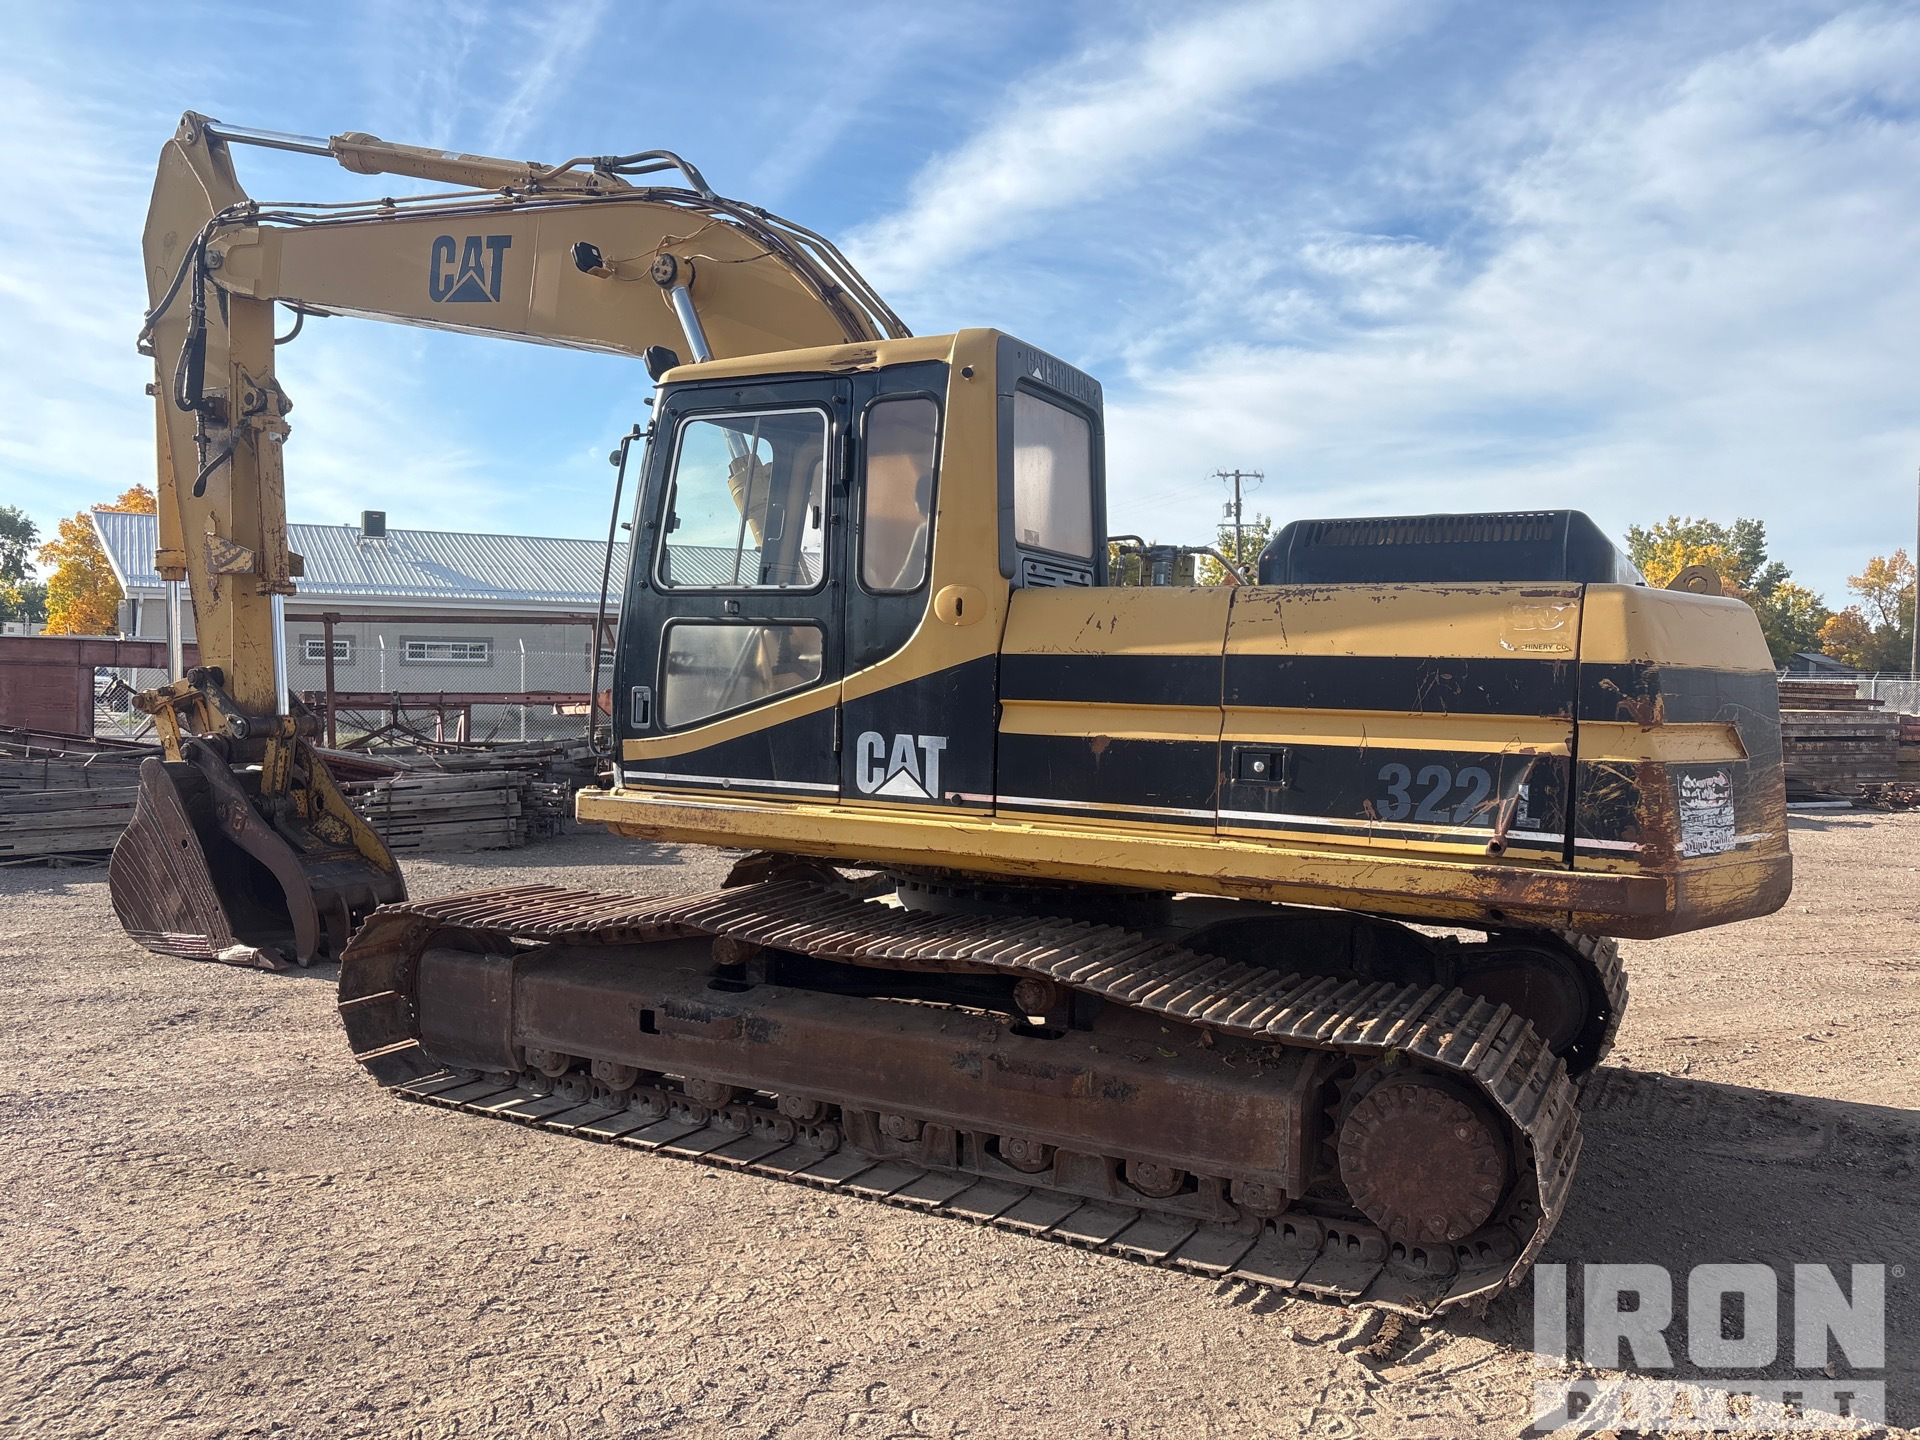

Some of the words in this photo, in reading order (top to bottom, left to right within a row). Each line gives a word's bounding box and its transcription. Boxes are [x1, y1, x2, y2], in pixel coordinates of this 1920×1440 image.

[429, 235, 513, 302] CAT
[1027, 347, 1093, 402] CATERPILLAR
[856, 731, 947, 798] CAT
[1377, 763, 1491, 825] 322
[1516, 783, 1540, 828] L
